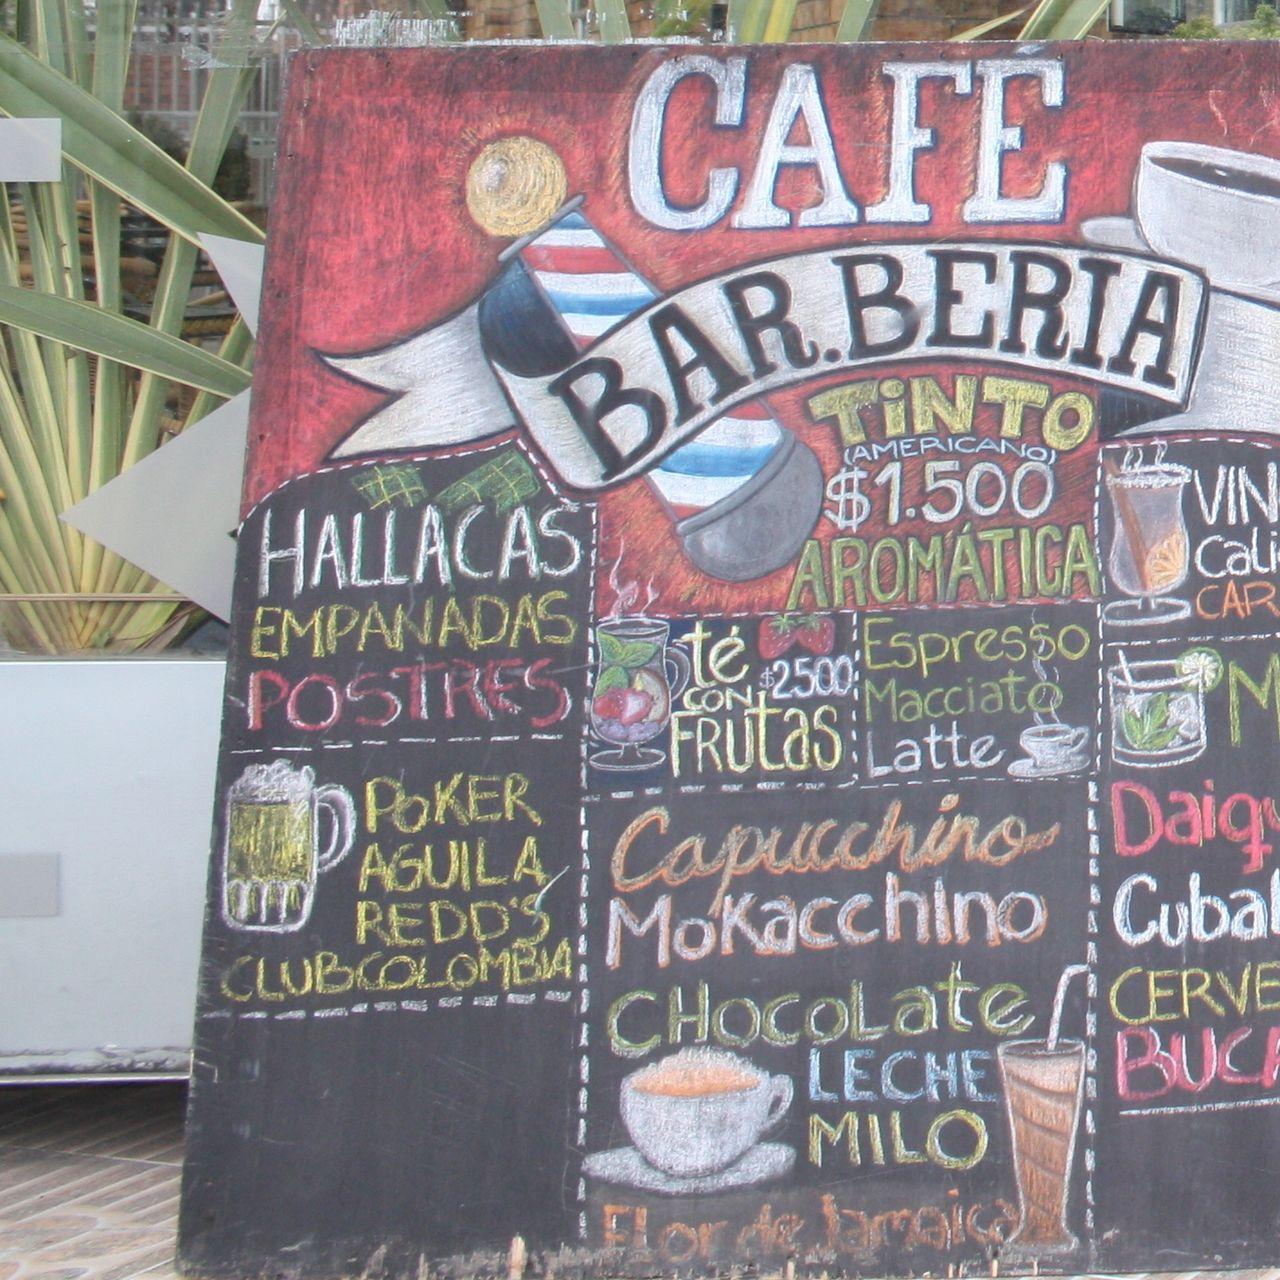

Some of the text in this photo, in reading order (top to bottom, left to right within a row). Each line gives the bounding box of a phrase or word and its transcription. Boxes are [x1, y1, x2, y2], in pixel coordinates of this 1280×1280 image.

[824, 460, 1054, 532] $1.500
[257, 504, 582, 598] HALLACAS
[251, 590, 577, 661] EMPANADAS
[864, 617, 1091, 678] Espresso
[247, 657, 573, 731] POSTRES
[864, 669, 1064, 722] Macciato
[867, 721, 1007, 778] Latte
[358, 836, 551, 892] AGUILA
[808, 1047, 998, 1103] LECHE
[808, 1108, 990, 1170] MILO
